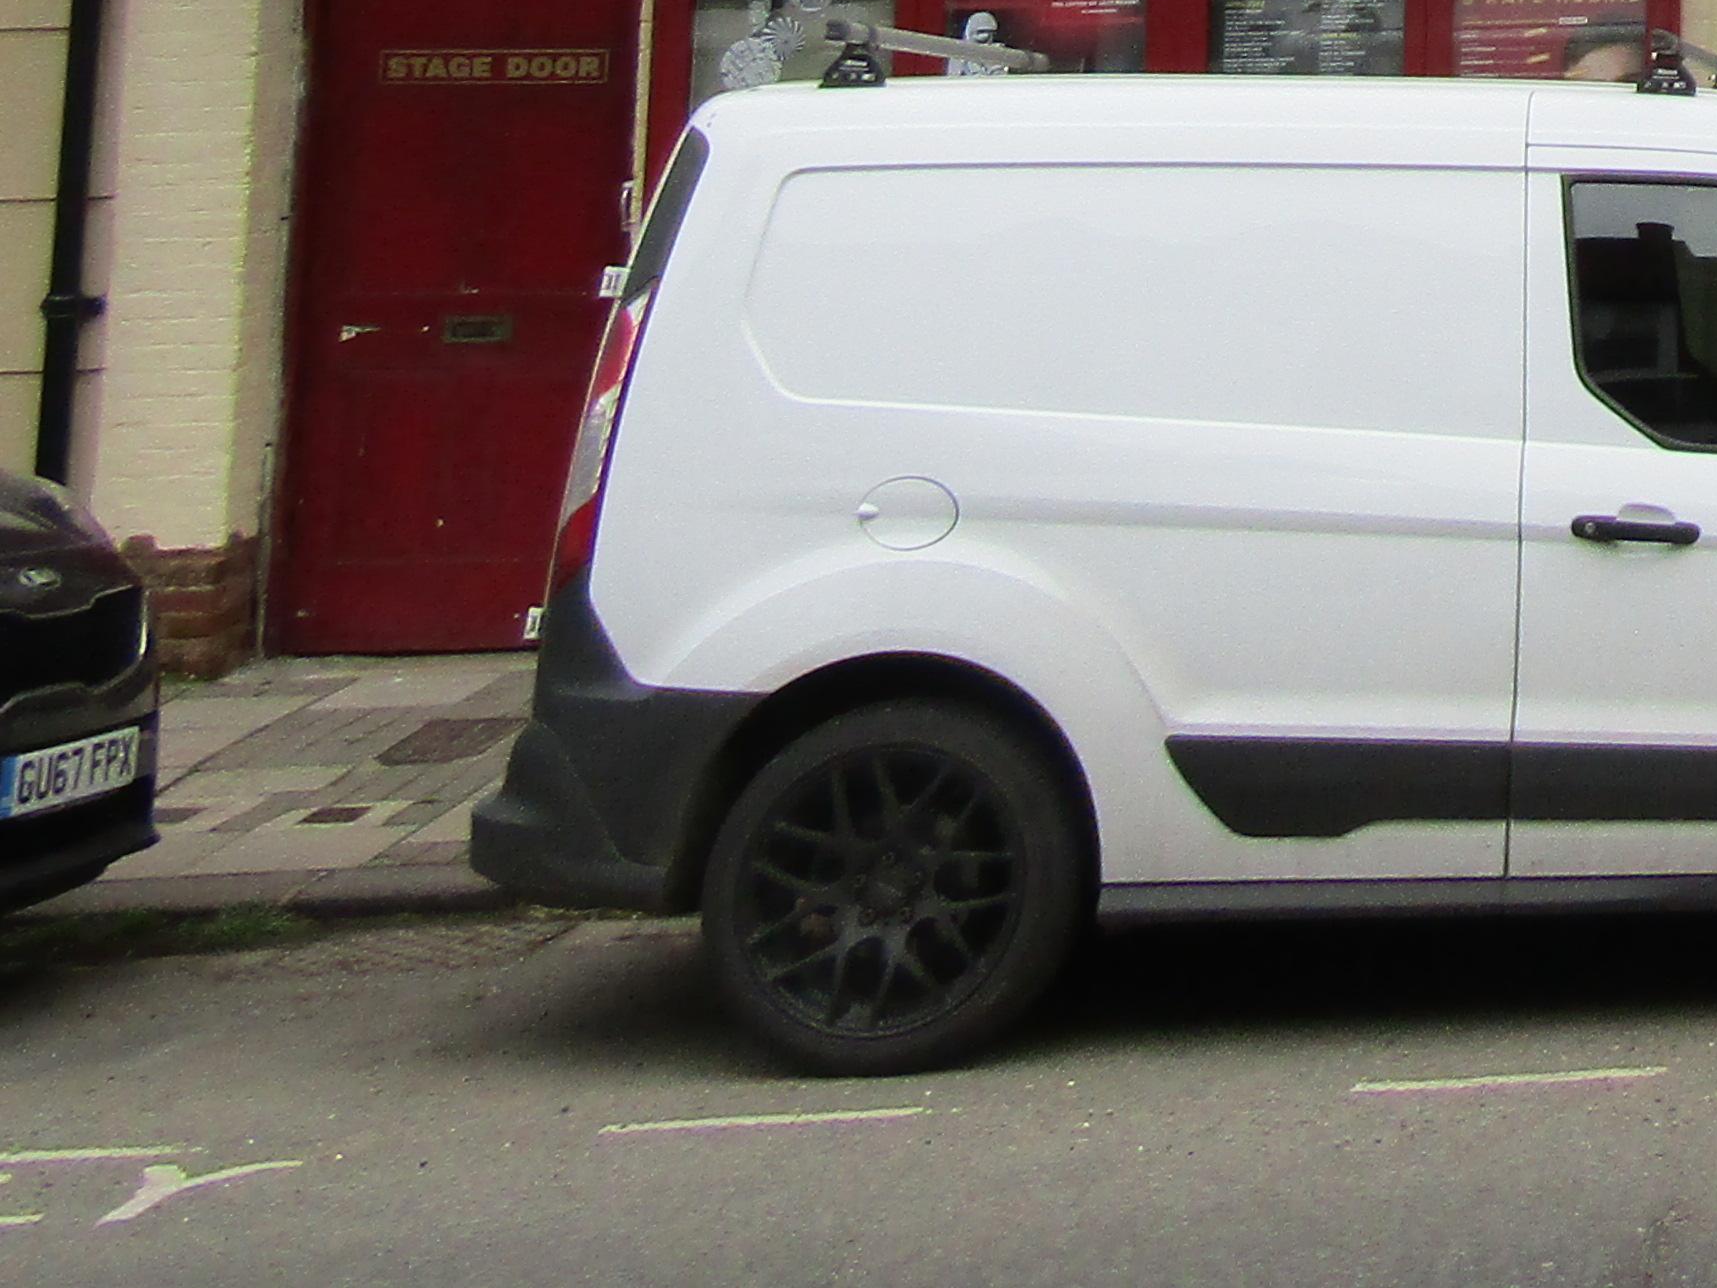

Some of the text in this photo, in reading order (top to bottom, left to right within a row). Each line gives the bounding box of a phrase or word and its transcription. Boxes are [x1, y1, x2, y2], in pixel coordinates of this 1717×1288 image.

[387, 56, 600, 78] STAGE DOOR
[17, 736, 135, 804] GU67 FPX
